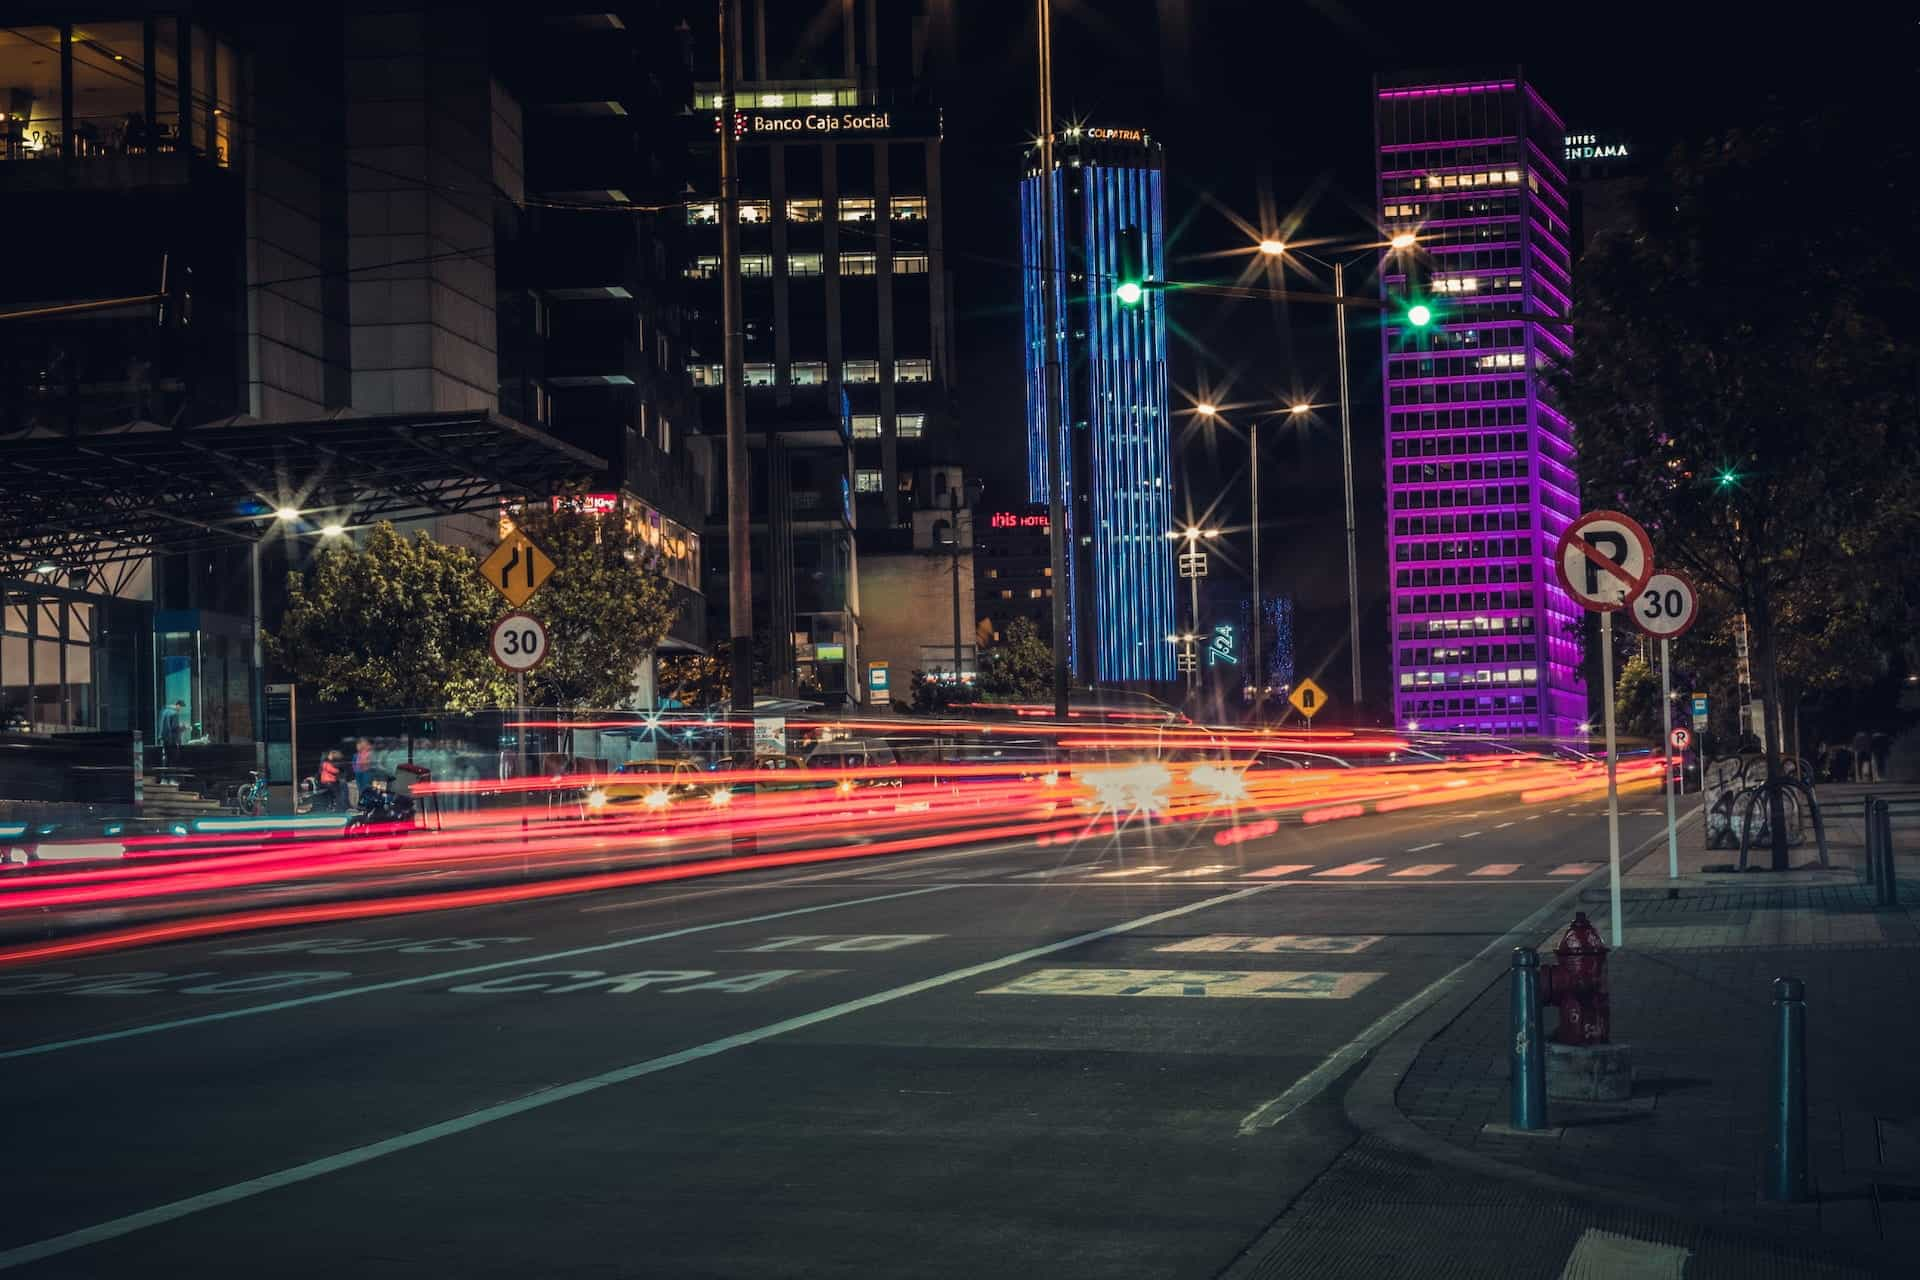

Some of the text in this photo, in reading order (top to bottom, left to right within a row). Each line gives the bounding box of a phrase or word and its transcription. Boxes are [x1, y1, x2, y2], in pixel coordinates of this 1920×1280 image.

[754, 113, 890, 132] Banco Caja Social
[1088, 128, 1140, 141] COLPATRIA
[991, 512, 1017, 527] ibis
[1584, 531, 1628, 595] P
[1643, 589, 1683, 618] 30
[503, 630, 537, 655] 30
[448, 969, 805, 993] CRA
